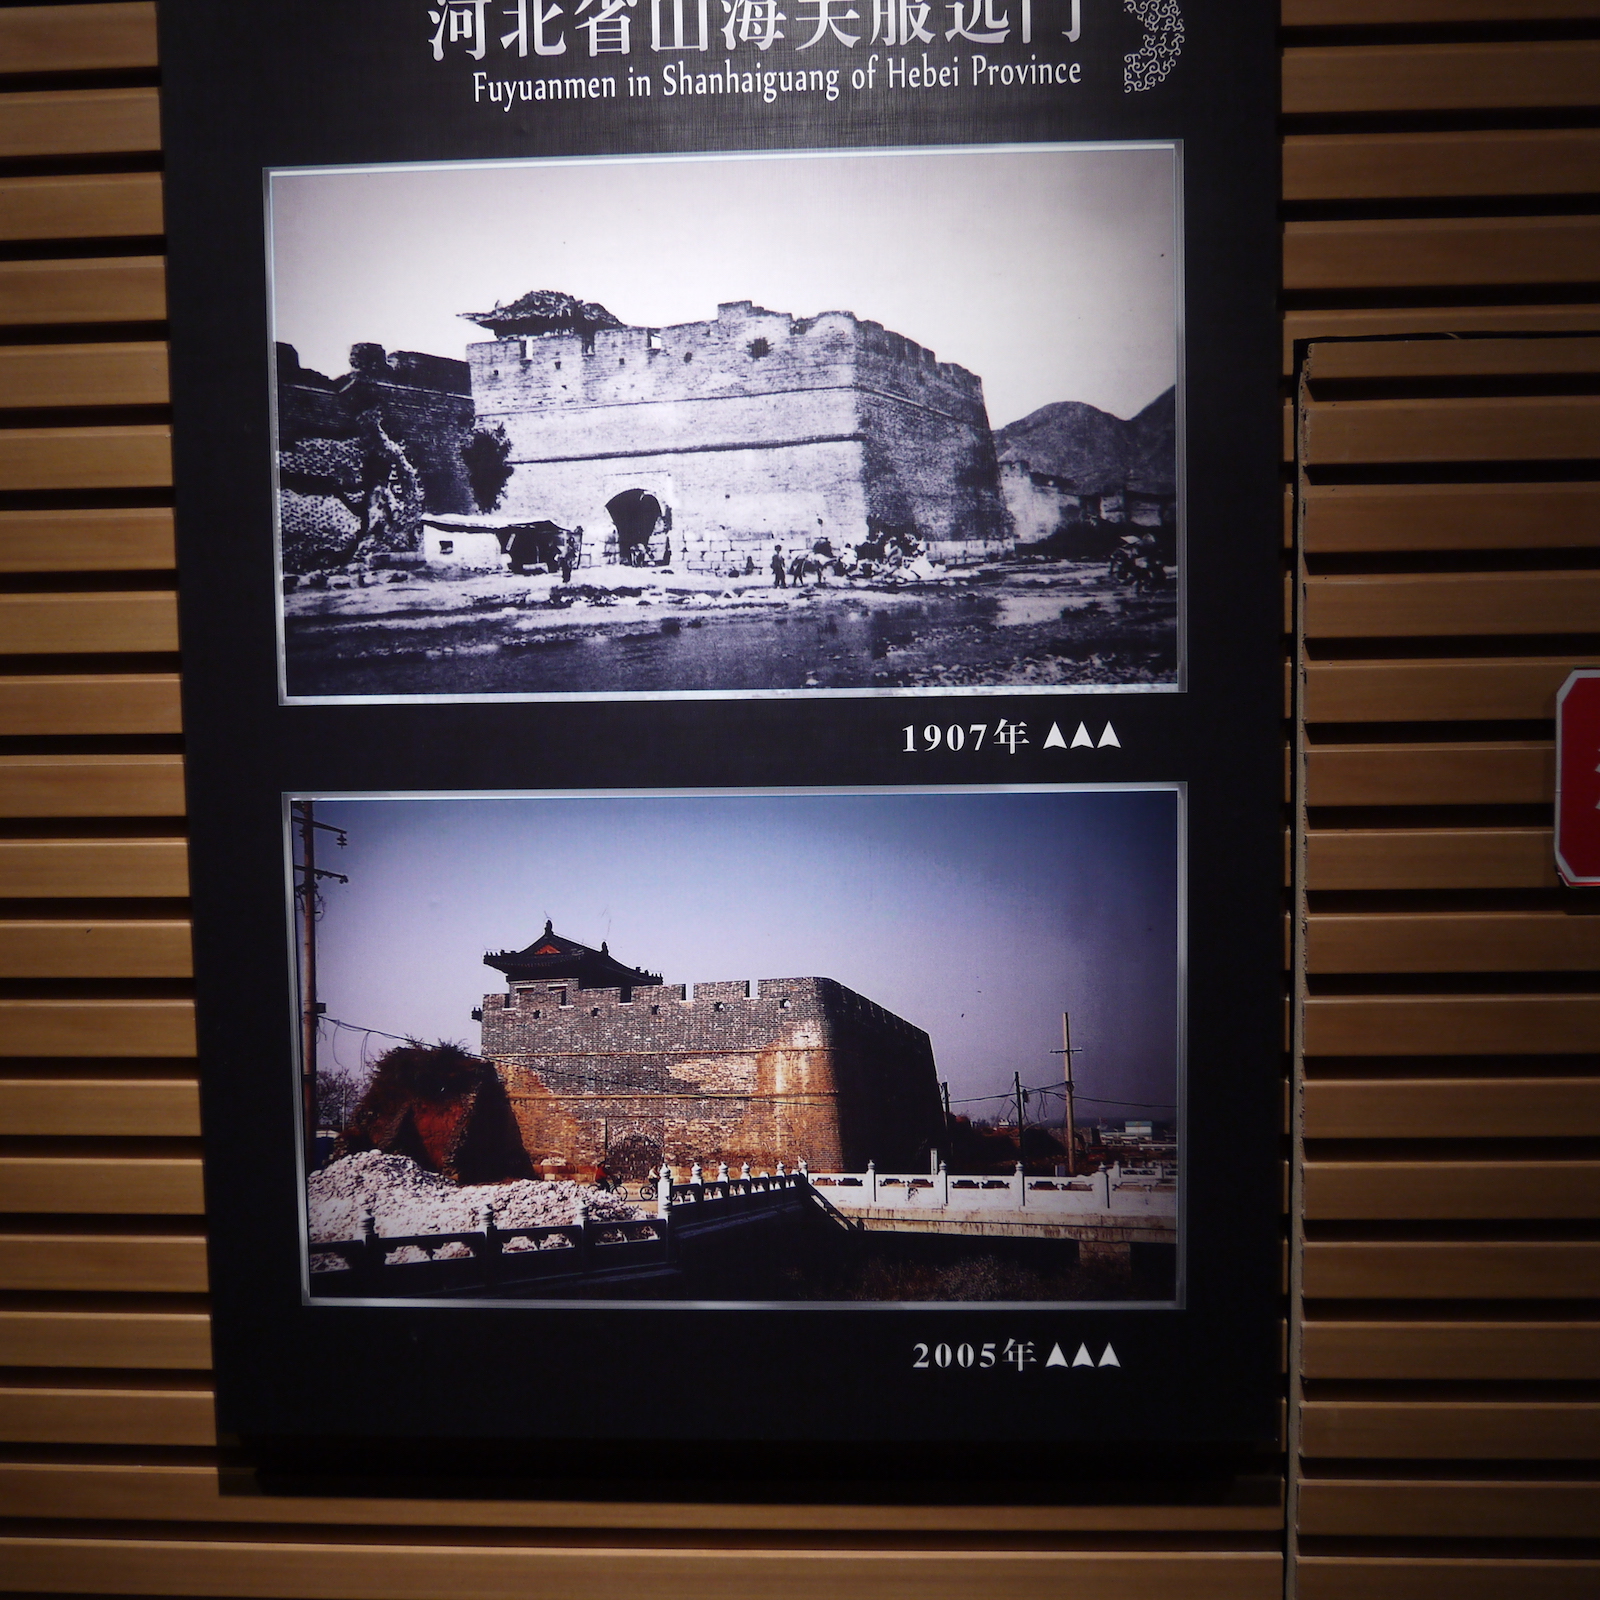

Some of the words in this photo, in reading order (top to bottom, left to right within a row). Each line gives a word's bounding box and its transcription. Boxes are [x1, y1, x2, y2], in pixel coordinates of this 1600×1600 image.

[472, 71, 616, 113] Fuyuanmen
[627, 66, 651, 97] in
[662, 58, 840, 104] Shanhaiguang
[851, 53, 879, 90] of
[886, 52, 959, 89] Hebei
[971, 54, 1082, 87] Province
[902, 718, 1031, 755] 1907年
[912, 1338, 1038, 1372] 2005年
